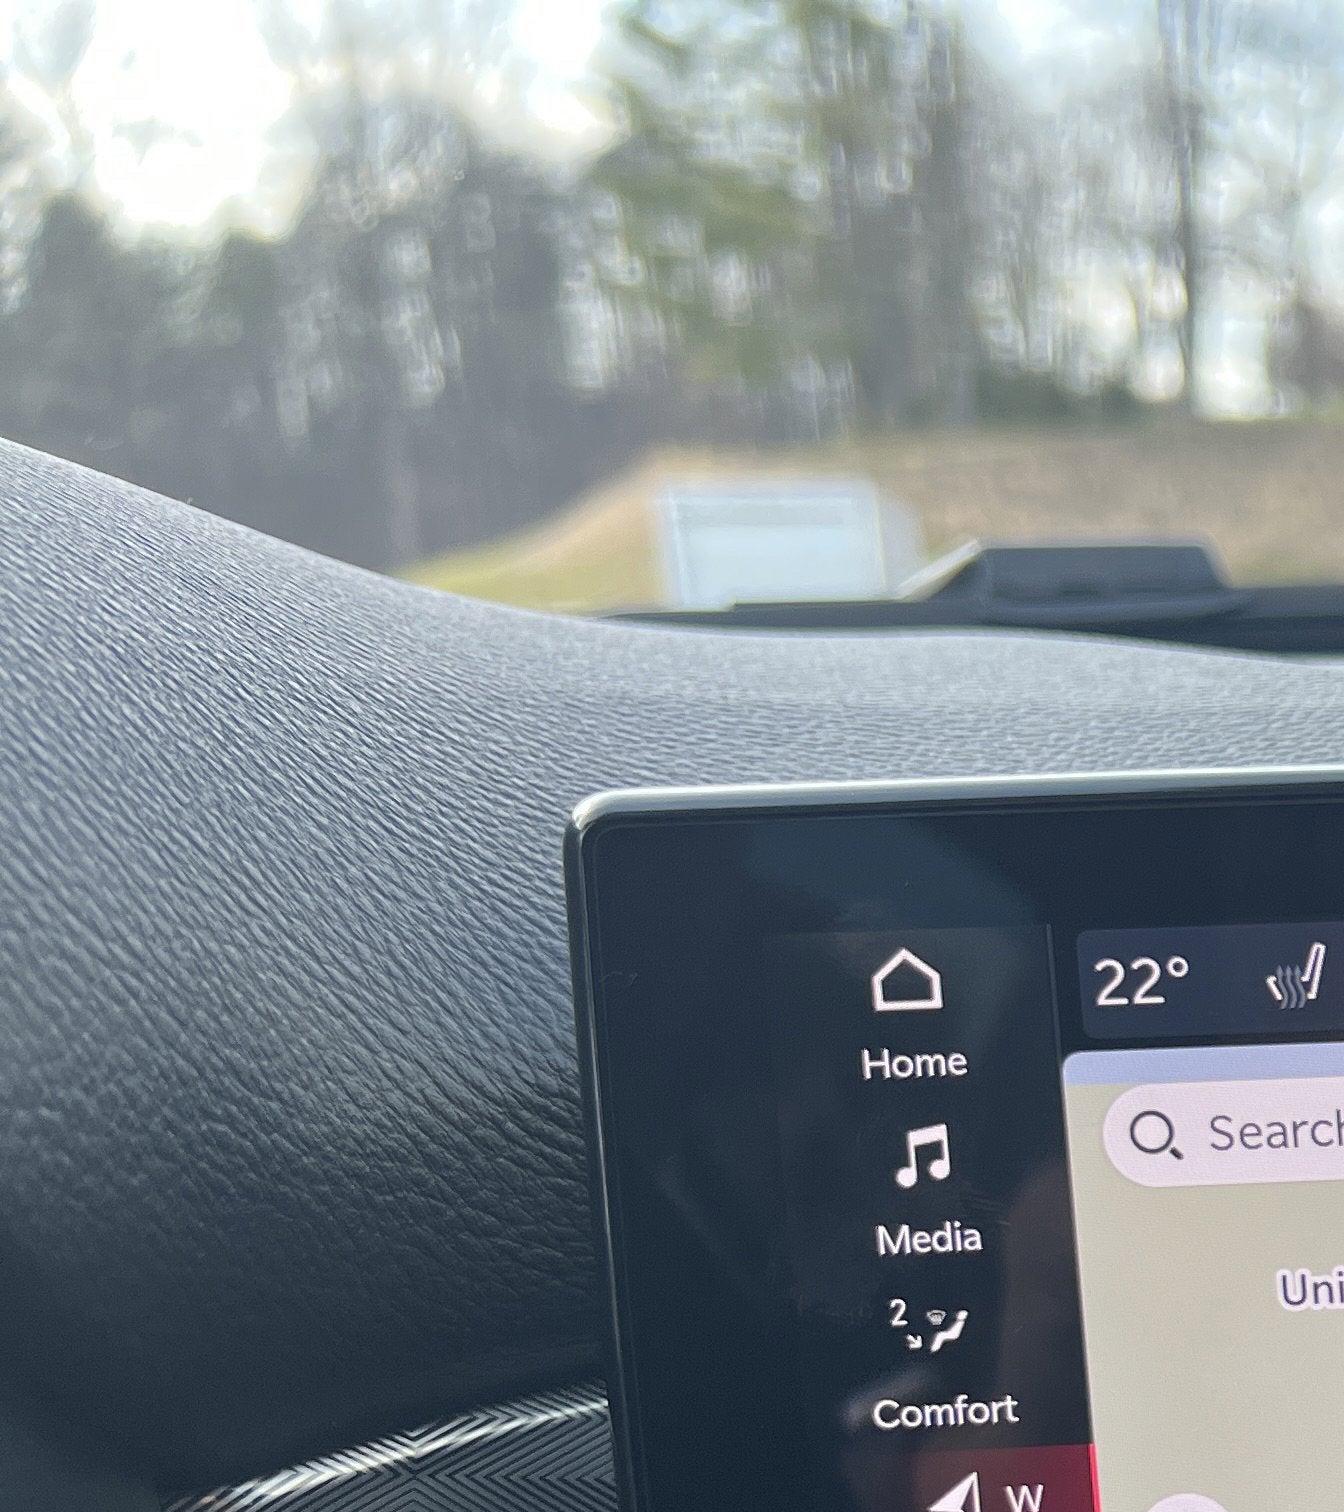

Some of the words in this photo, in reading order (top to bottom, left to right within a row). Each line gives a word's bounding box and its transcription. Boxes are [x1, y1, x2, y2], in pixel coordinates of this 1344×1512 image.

[1094, 957, 1189, 1006] 22°
[862, 1048, 968, 1080] Home
[875, 1222, 983, 1255] Media
[890, 1299, 908, 1326] 2
[873, 1394, 1020, 1429] Comfort
